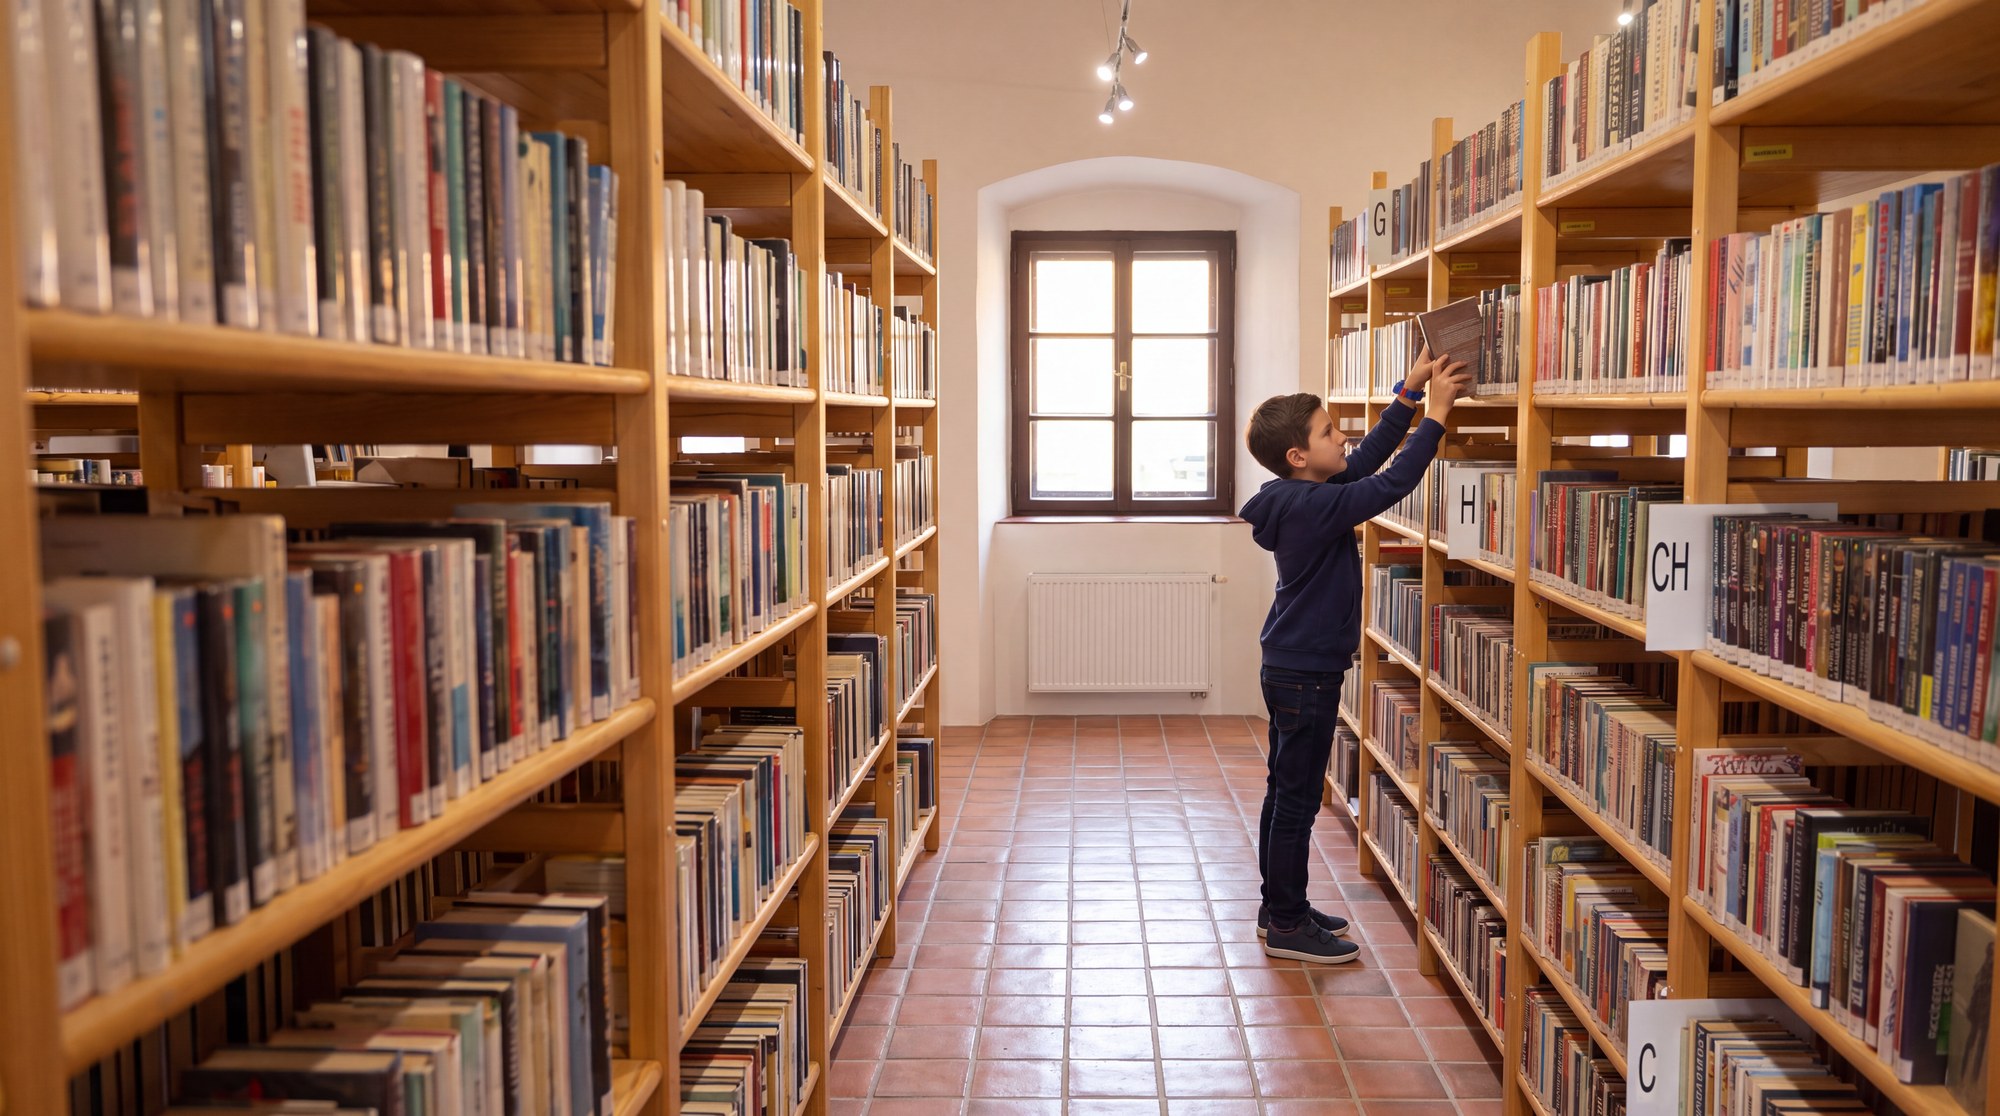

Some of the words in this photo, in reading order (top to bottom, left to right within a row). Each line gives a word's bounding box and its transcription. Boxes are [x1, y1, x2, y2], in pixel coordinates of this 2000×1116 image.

[1373, 201, 1386, 237] G
[1460, 484, 1476, 525] H
[1651, 541, 1690, 593] CH
[1638, 1042, 1657, 1093] C
